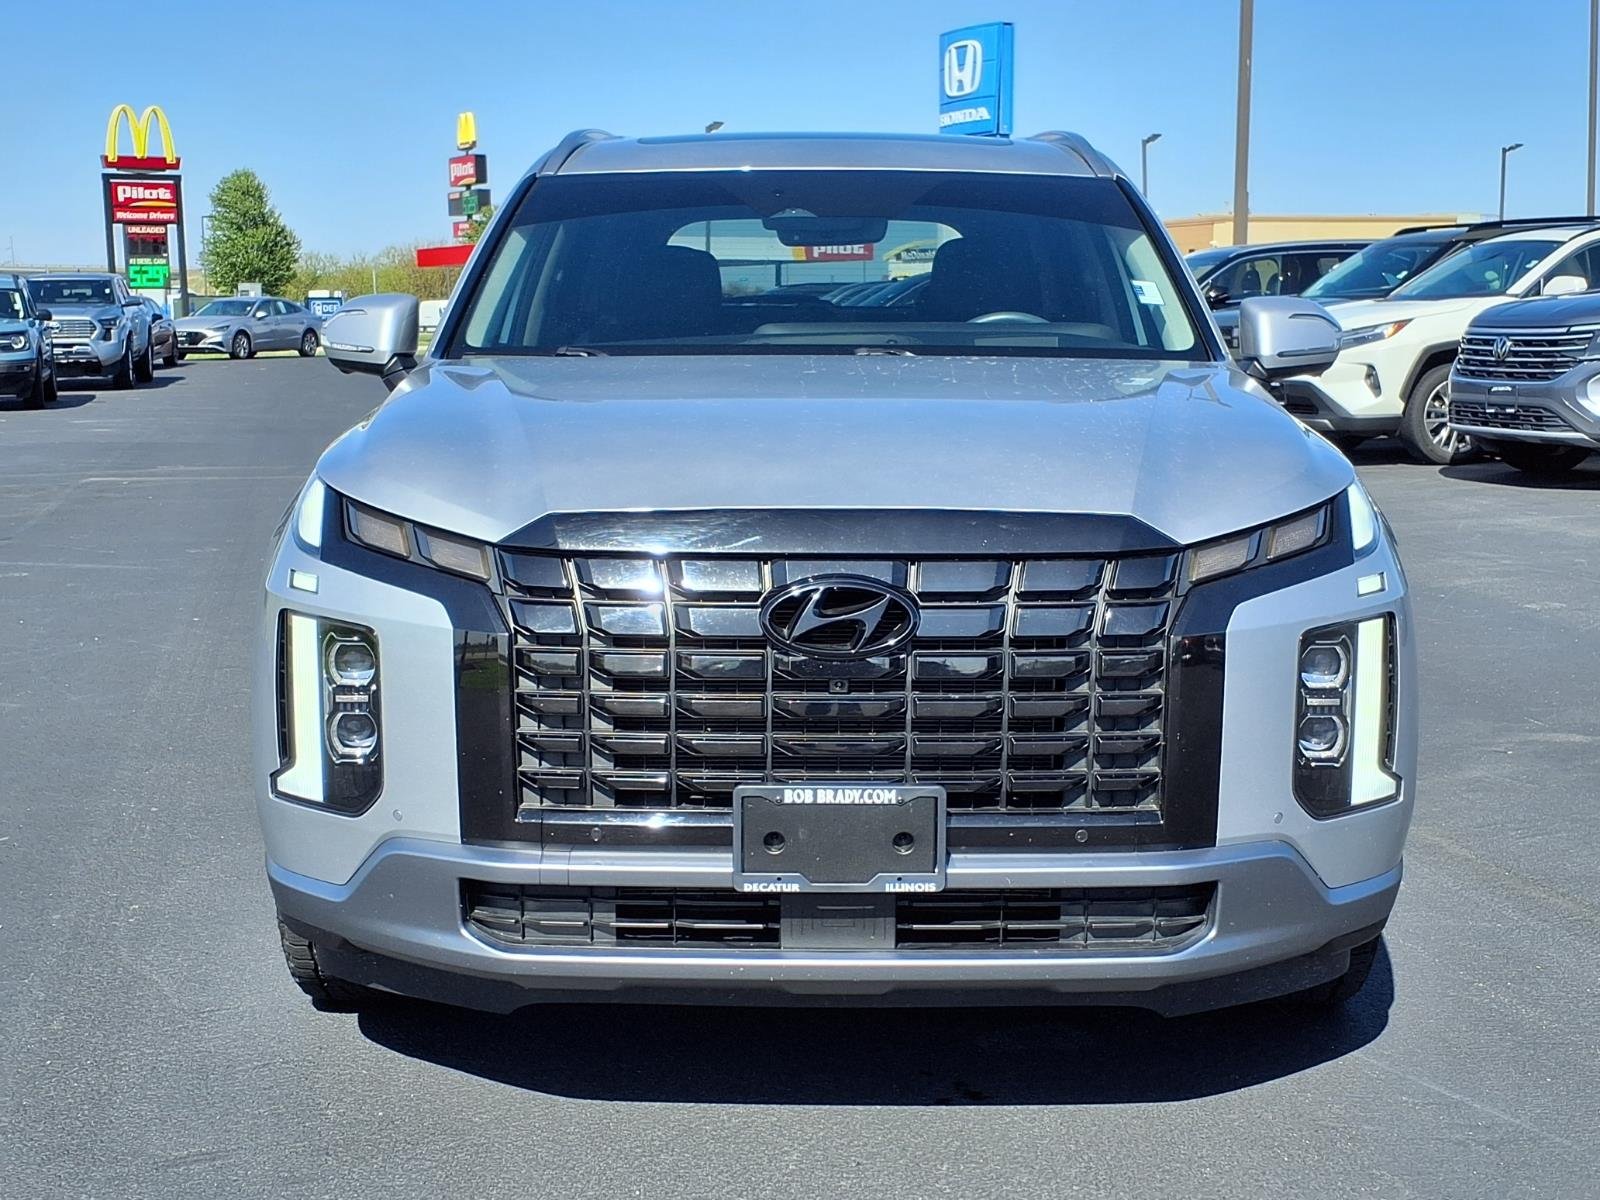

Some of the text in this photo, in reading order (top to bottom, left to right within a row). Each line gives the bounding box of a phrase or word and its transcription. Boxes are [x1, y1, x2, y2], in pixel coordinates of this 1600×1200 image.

[117, 186, 171, 202] Pilot
[116, 211, 175, 220] Welcome Drivers
[784, 789, 897, 804] BOB BRADY.COM
[743, 883, 800, 893] DECATUR
[885, 882, 937, 892] ILLINOIS
